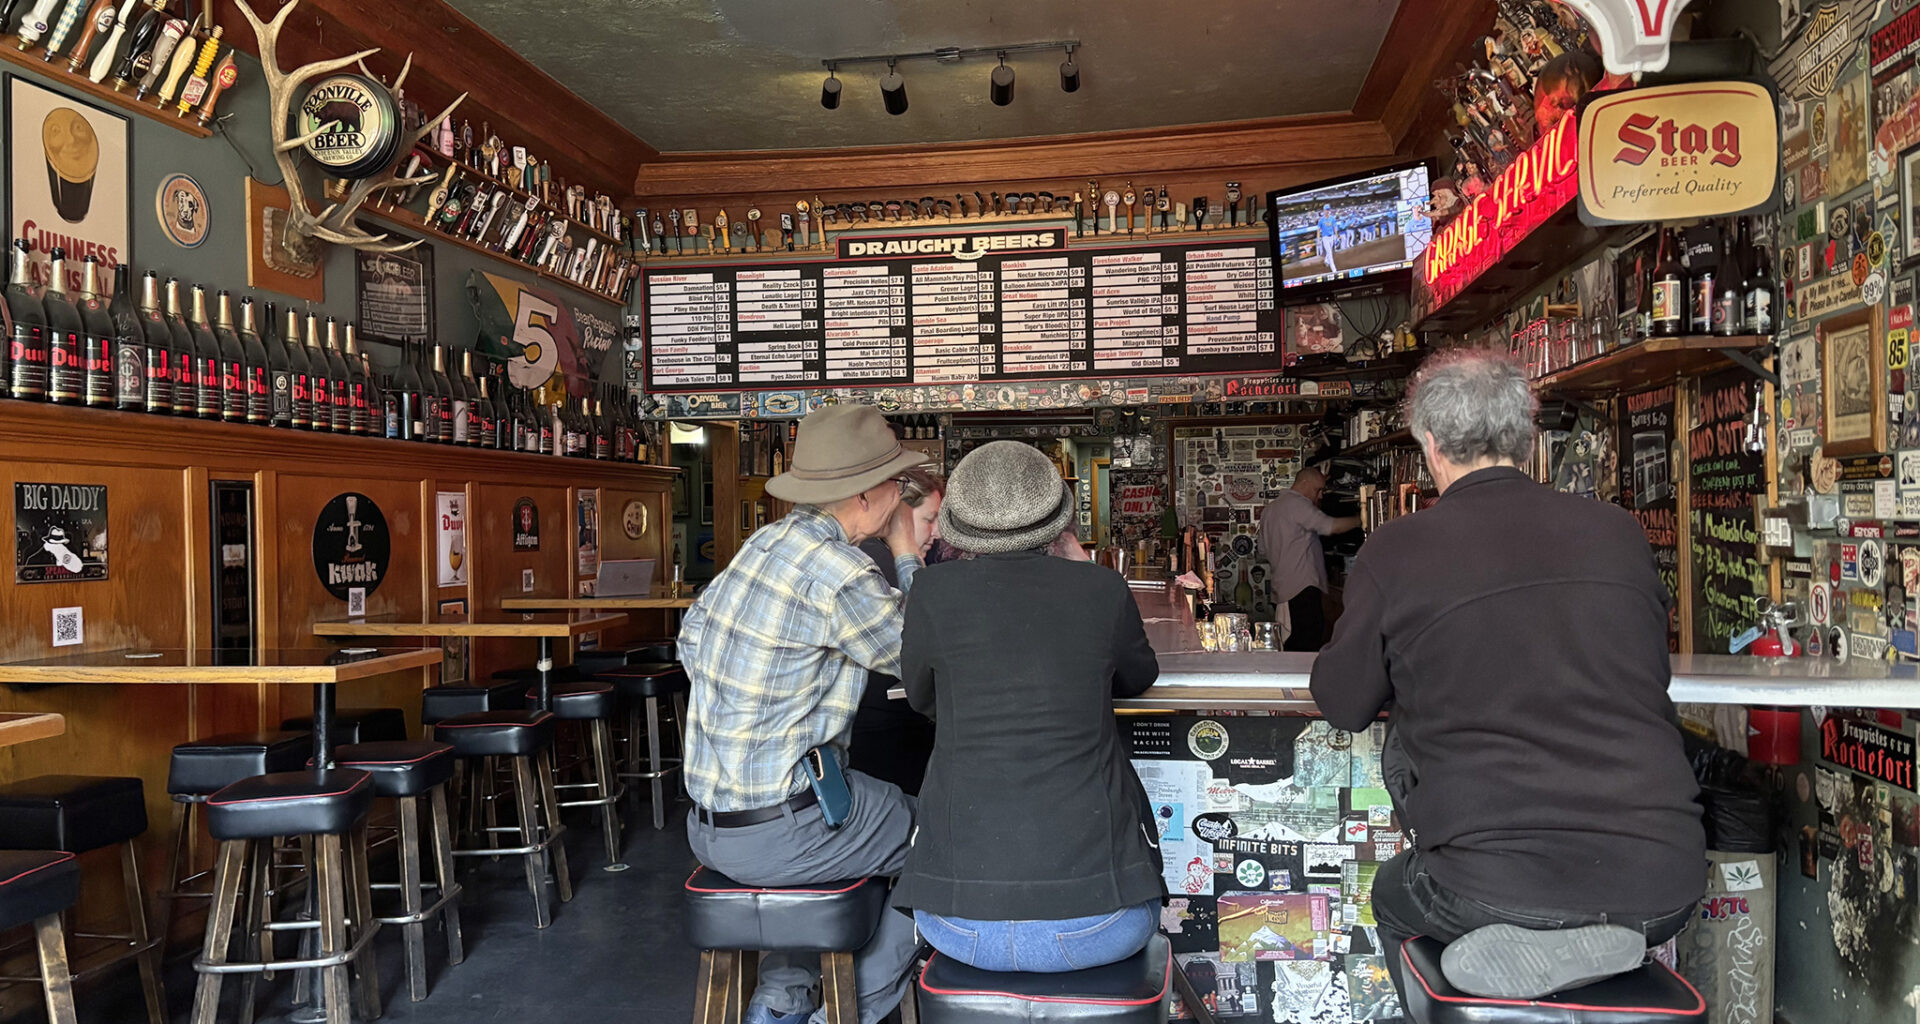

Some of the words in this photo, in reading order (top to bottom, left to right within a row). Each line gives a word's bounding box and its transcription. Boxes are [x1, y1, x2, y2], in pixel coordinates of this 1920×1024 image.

[1808, 10, 1836, 44] MOTOR
[1809, 56, 1838, 92] CYCLES
[302, 85, 373, 117] BOONVILLE
[314, 133, 361, 149] BEER
[1613, 112, 1742, 168] Stag
[1660, 155, 1698, 168] BEER
[1612, 180, 1680, 204] Preferred
[1685, 178, 1743, 196] Quality
[22, 218, 118, 271] GUINNESS
[848, 237, 967, 256] DRAUGHT
[972, 232, 1055, 251] BEERS
[1424, 191, 1487, 285] GARAGE
[506, 287, 561, 391] 5
[1888, 338, 1906, 369] 85
[1714, 380, 1749, 416] CANS
[1690, 426, 1714, 461] AND
[22, 484, 48, 510] BIG
[50, 485, 100, 511] DADDY
[1122, 486, 1154, 500] CASH
[1123, 501, 1153, 513] ONLY
[1842, 718, 1888, 748] Trappistes
[1823, 717, 1913, 790] Rochefort
[1218, 838, 1267, 854] INFINITE
[1270, 842, 1298, 856] BITS
